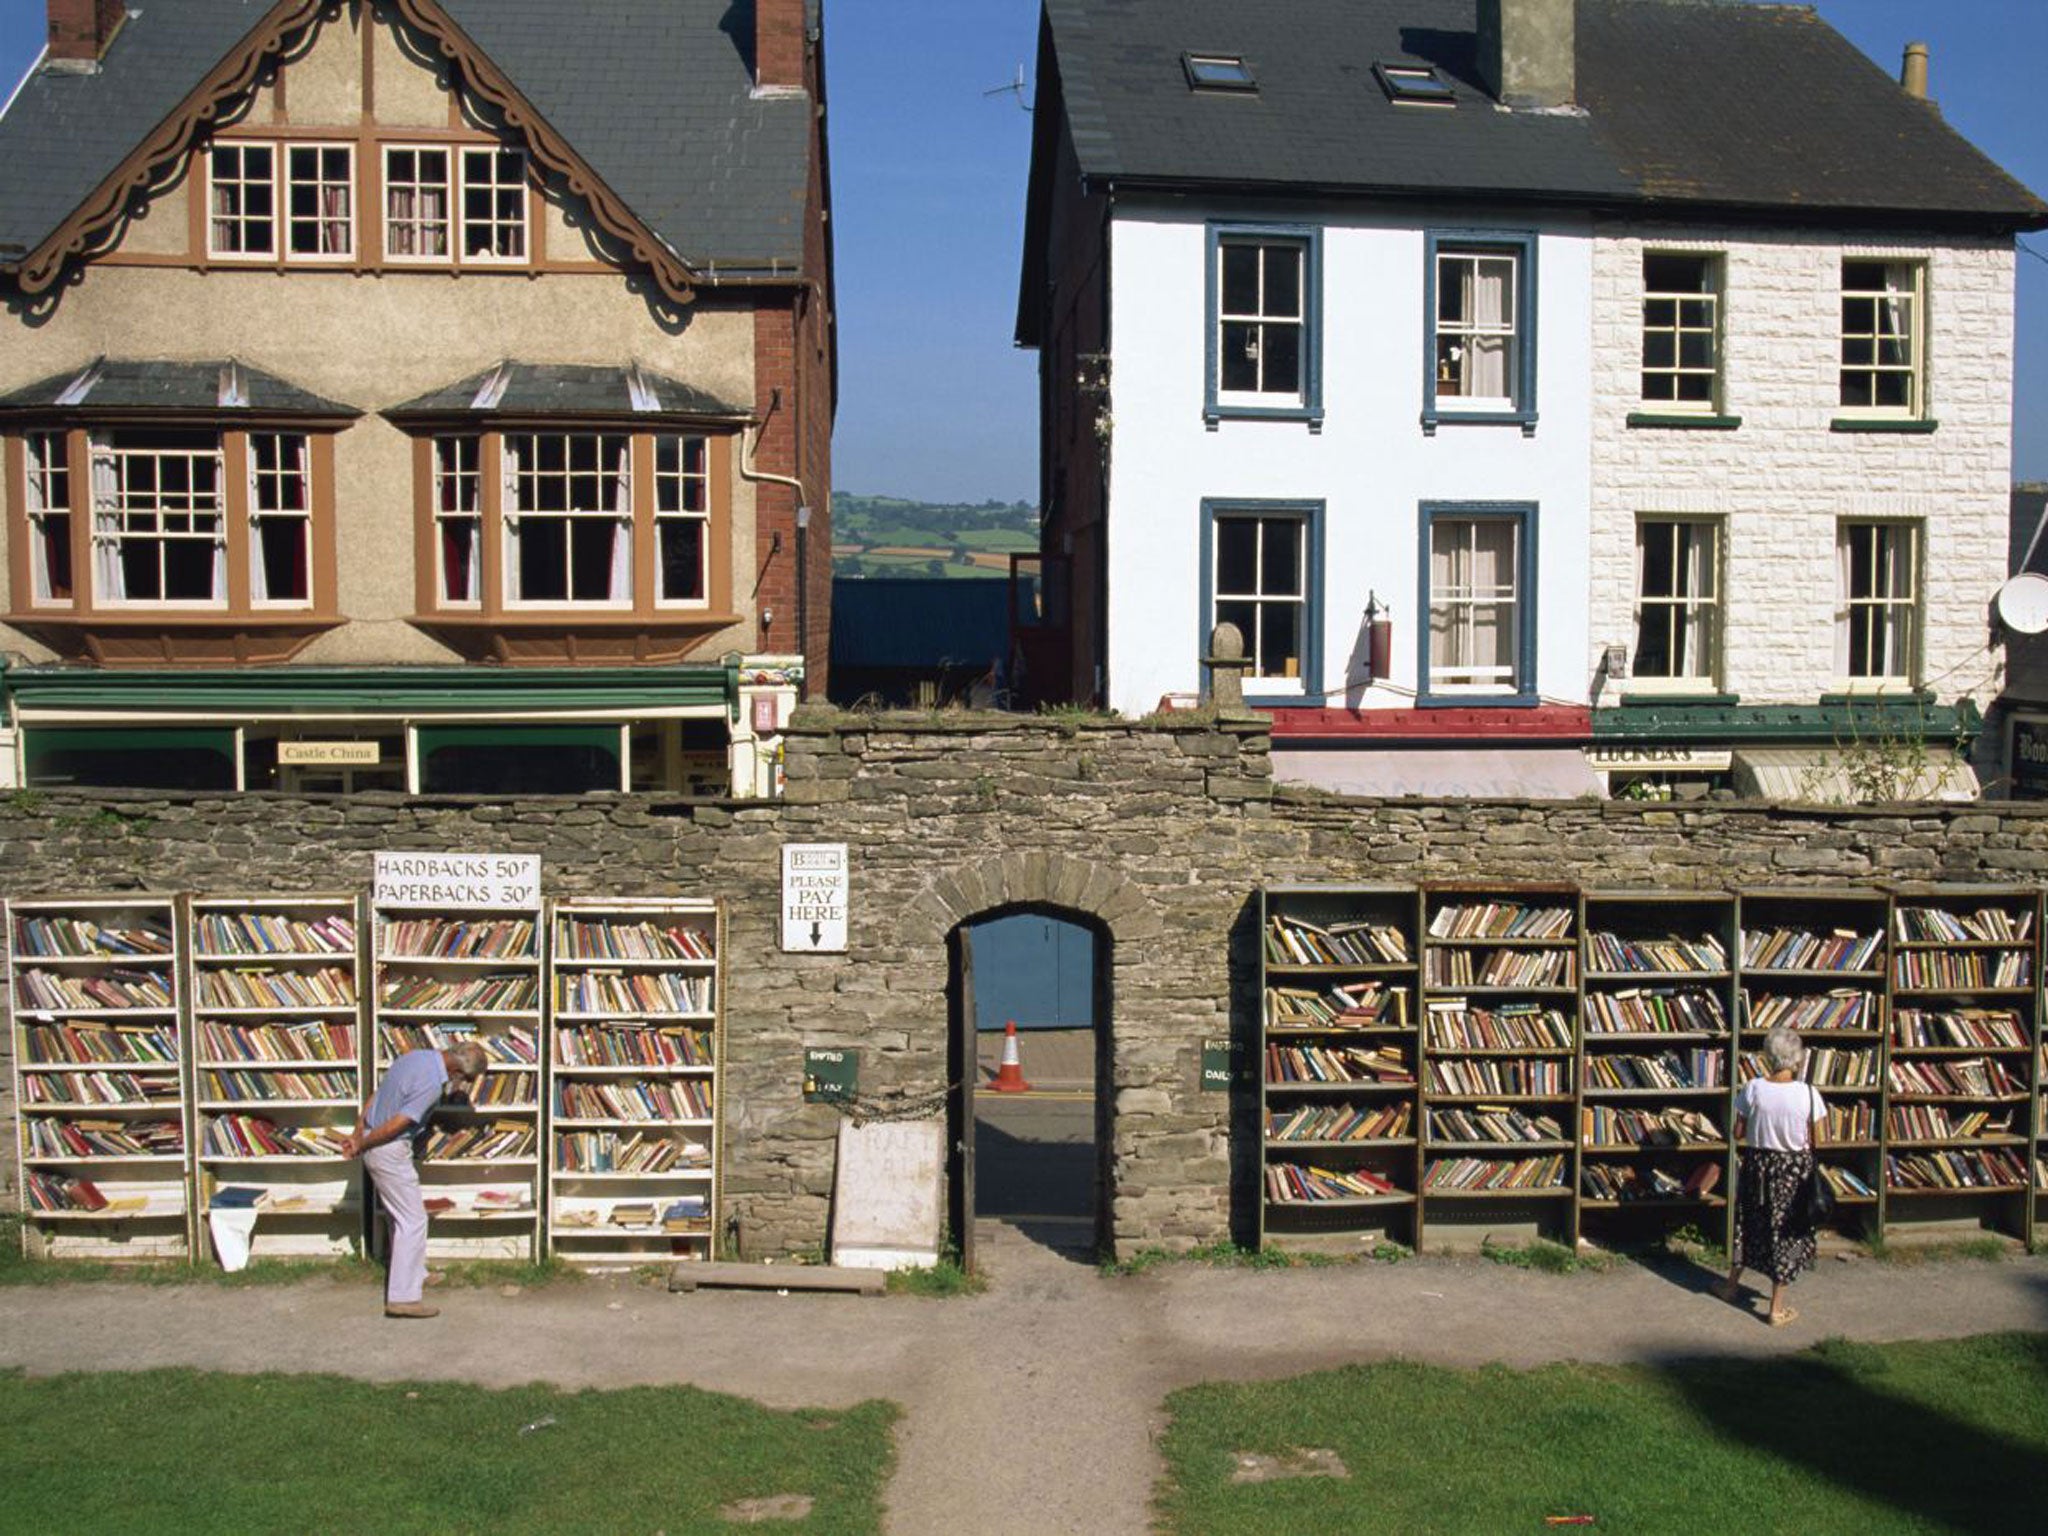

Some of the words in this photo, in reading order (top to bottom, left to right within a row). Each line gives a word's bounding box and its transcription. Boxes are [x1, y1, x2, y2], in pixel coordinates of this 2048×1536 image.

[285, 747, 326, 759] Castle
[331, 747, 371, 759] China
[2018, 733, 2048, 762] Boo
[378, 859, 489, 878] HARDBACKS
[790, 876, 841, 887] PLEASE
[378, 884, 490, 902] PAPERBACKS
[799, 890, 834, 904] PAY
[790, 906, 843, 920] HERE
[1205, 1069, 1235, 1081] DAILY
